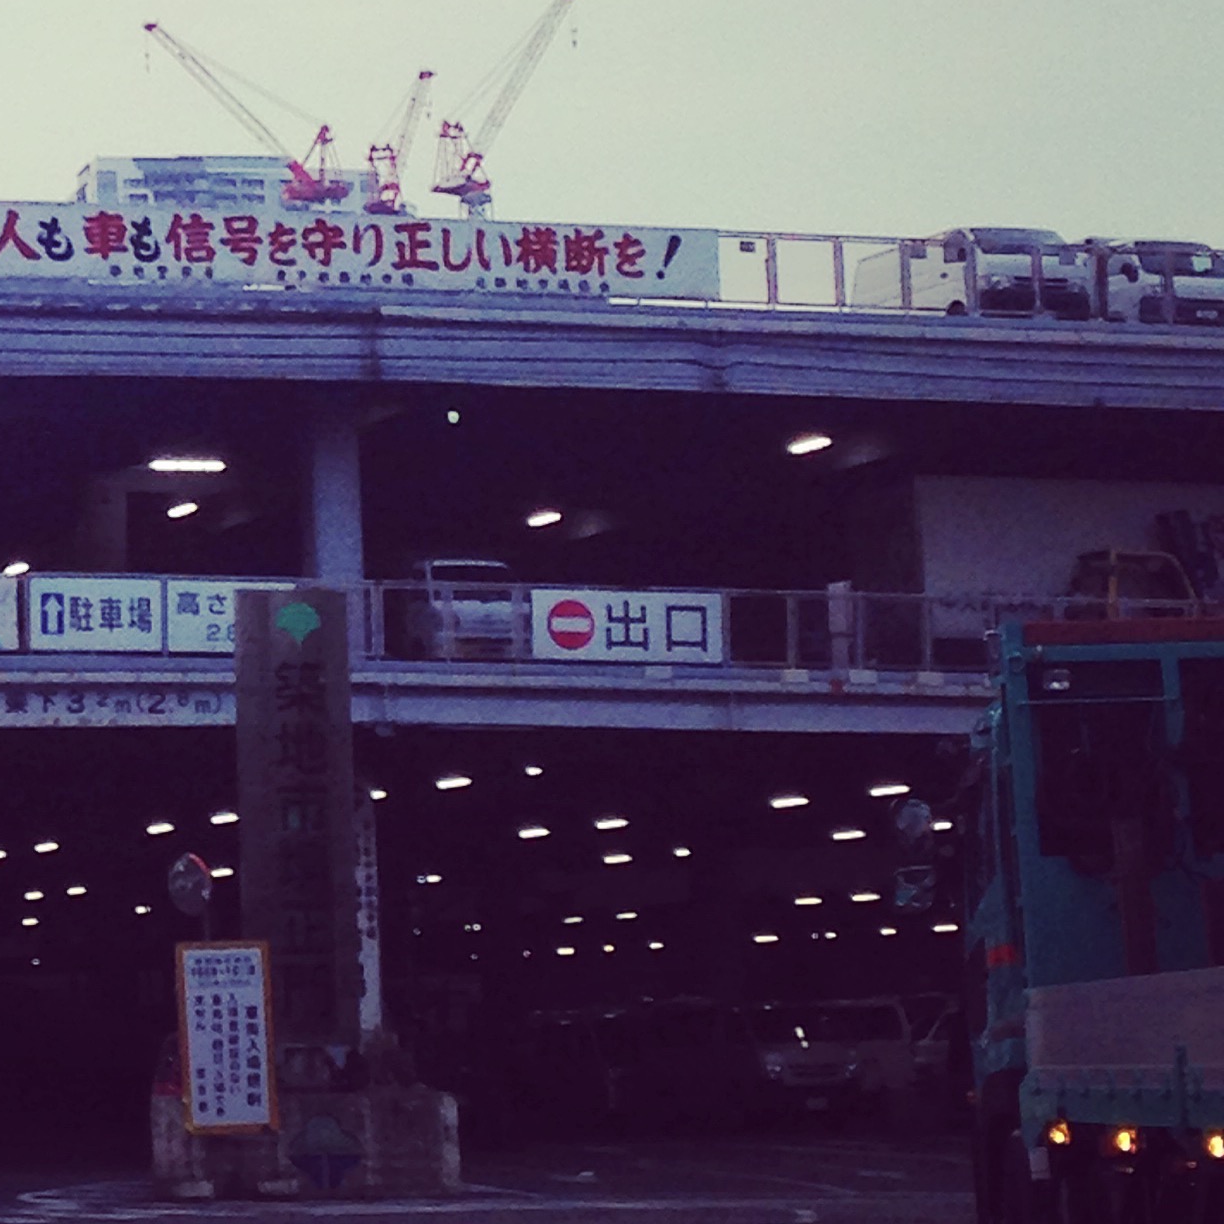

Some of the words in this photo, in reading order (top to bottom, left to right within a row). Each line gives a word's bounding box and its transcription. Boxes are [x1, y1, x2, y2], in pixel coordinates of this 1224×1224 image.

[69, 596, 153, 633] 駐車場
[177, 591, 227, 616] 高さ
[605, 599, 708, 654] 出口
